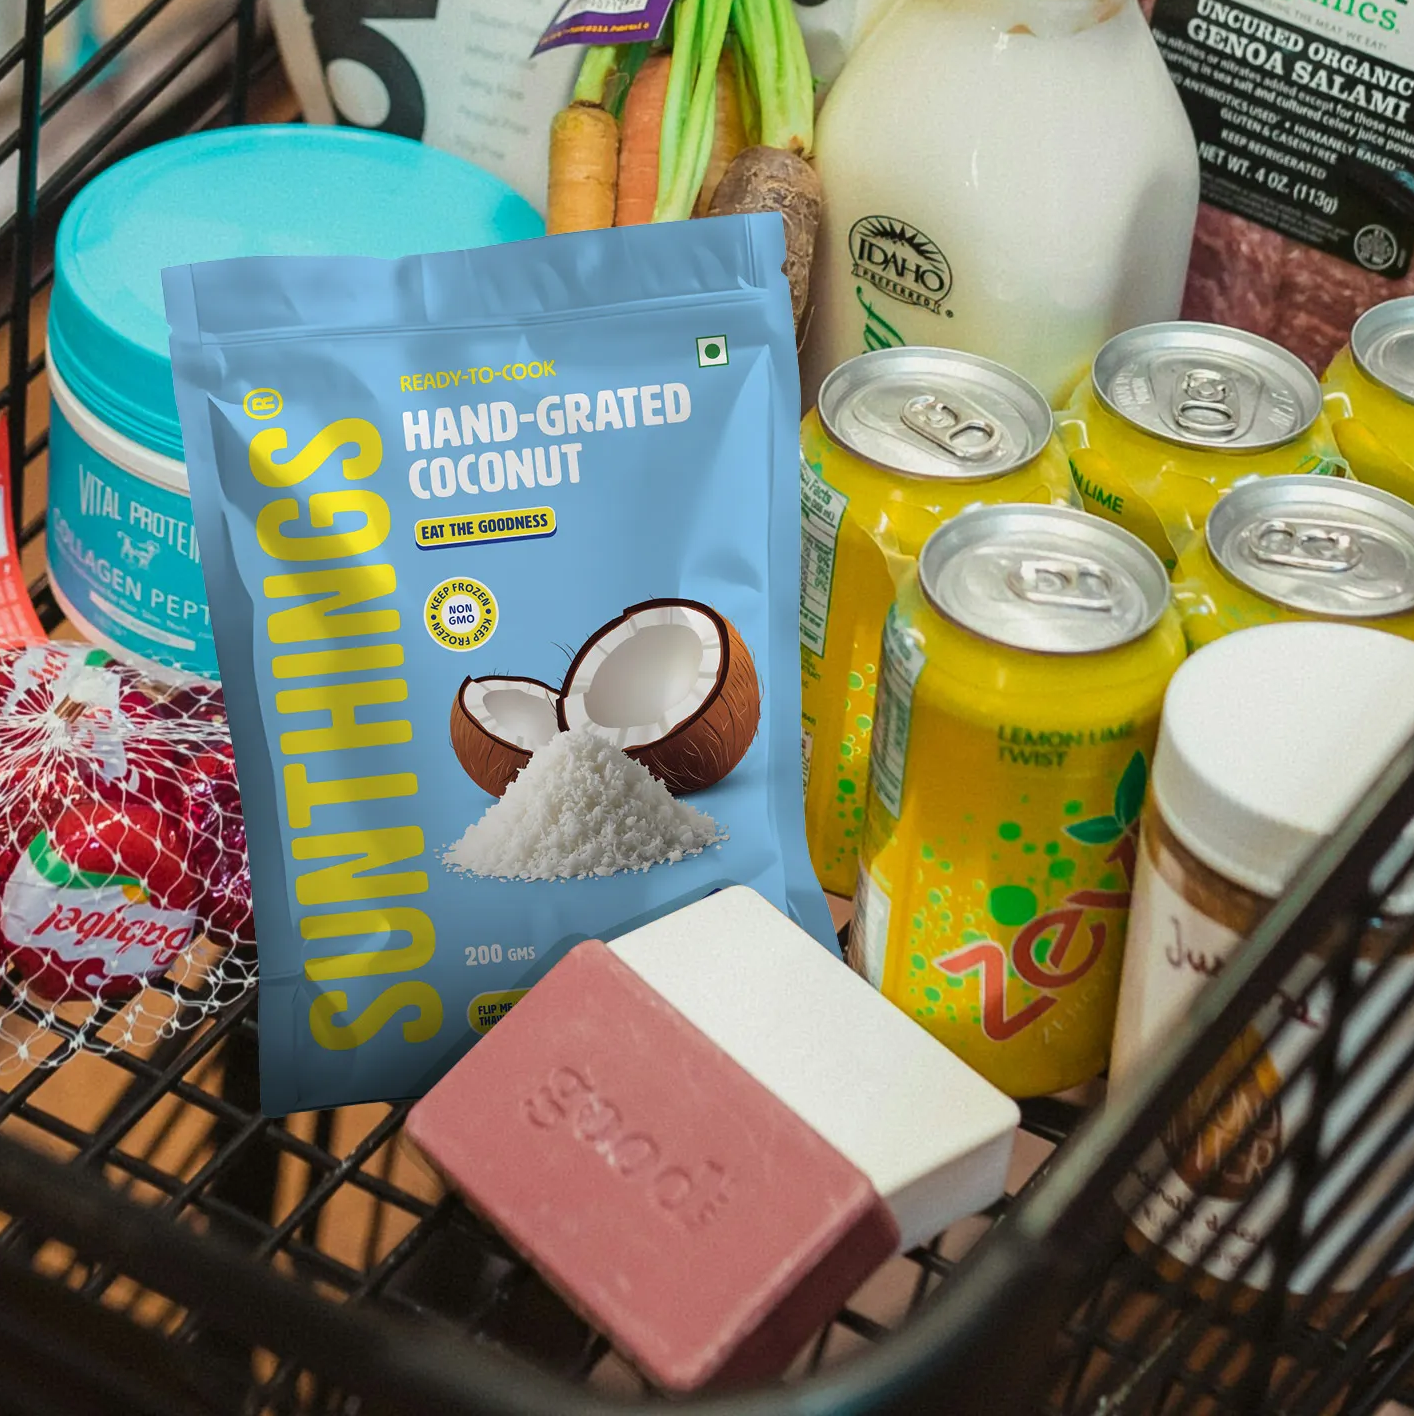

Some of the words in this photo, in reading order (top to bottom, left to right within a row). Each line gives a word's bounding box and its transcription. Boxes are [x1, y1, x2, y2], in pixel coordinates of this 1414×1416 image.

[1294, 7, 1314, 24] THE
[1167, 30, 1207, 60] nitrites
[1206, 49, 1220, 63] or
[1219, 52, 1261, 84] nitrates
[1262, 74, 1299, 100] added
[1297, 87, 1335, 116] except
[1336, 102, 1353, 121] for
[1353, 107, 1386, 132] those
[1187, 17, 1285, 77] GENOA
[1291, 59, 1412, 124] SALAMI
[1183, 79, 1249, 117] ANTIBIOTICS
[1293, 123, 1353, 156] HUMANELY
[1201, 61, 1211, 77] in
[1211, 69, 1232, 85] sea
[1232, 73, 1253, 95] salt
[1253, 83, 1275, 105] and
[1275, 90, 1322, 124] cultured
[1322, 113, 1357, 139] celery
[1356, 127, 1386, 149] juice
[1220, 107, 1263, 134] GLUTEN
[1262, 124, 1270, 137] &
[1271, 129, 1311, 155] CASEIN
[1311, 143, 1338, 165] FREE
[1220, 128, 1246, 149] KEEP
[1245, 137, 1327, 181] REFRIGERATED
[1198, 141, 1224, 166] NET
[1227, 149, 1251, 179] WT.
[1254, 167, 1266, 184] 4
[1267, 172, 1290, 194] OZ.
[1292, 182, 1339, 215] (113g)
[858, 237, 945, 293] IDAHO
[862, 268, 931, 307] PREFERRED
[400, 360, 557, 393] READY-TO-COOK
[402, 382, 692, 452] HAND-GRATED
[408, 442, 583, 500] COCONUT
[78, 463, 123, 521] VITAL
[1084, 479, 1124, 516] LIME
[421, 523, 448, 541] EAT
[449, 519, 475, 537] THE
[477, 513, 549, 535] GOODNESS
[52, 507, 142, 602] COLLAGEN
[430, 586, 450, 611] KEEP
[451, 582, 491, 607] FROZEN
[448, 603, 473, 615] NON
[431, 621, 471, 646] FROZEN
[448, 614, 475, 626] GMO
[473, 617, 493, 643] KEEP
[997, 724, 1084, 747] LEMON
[1089, 719, 1134, 746] LIME
[998, 745, 1068, 768] TWIST
[36, 902, 193, 968] Babybel
[464, 943, 503, 966] 200
[507, 946, 536, 962] GMS
[477, 1004, 497, 1015] FLIP
